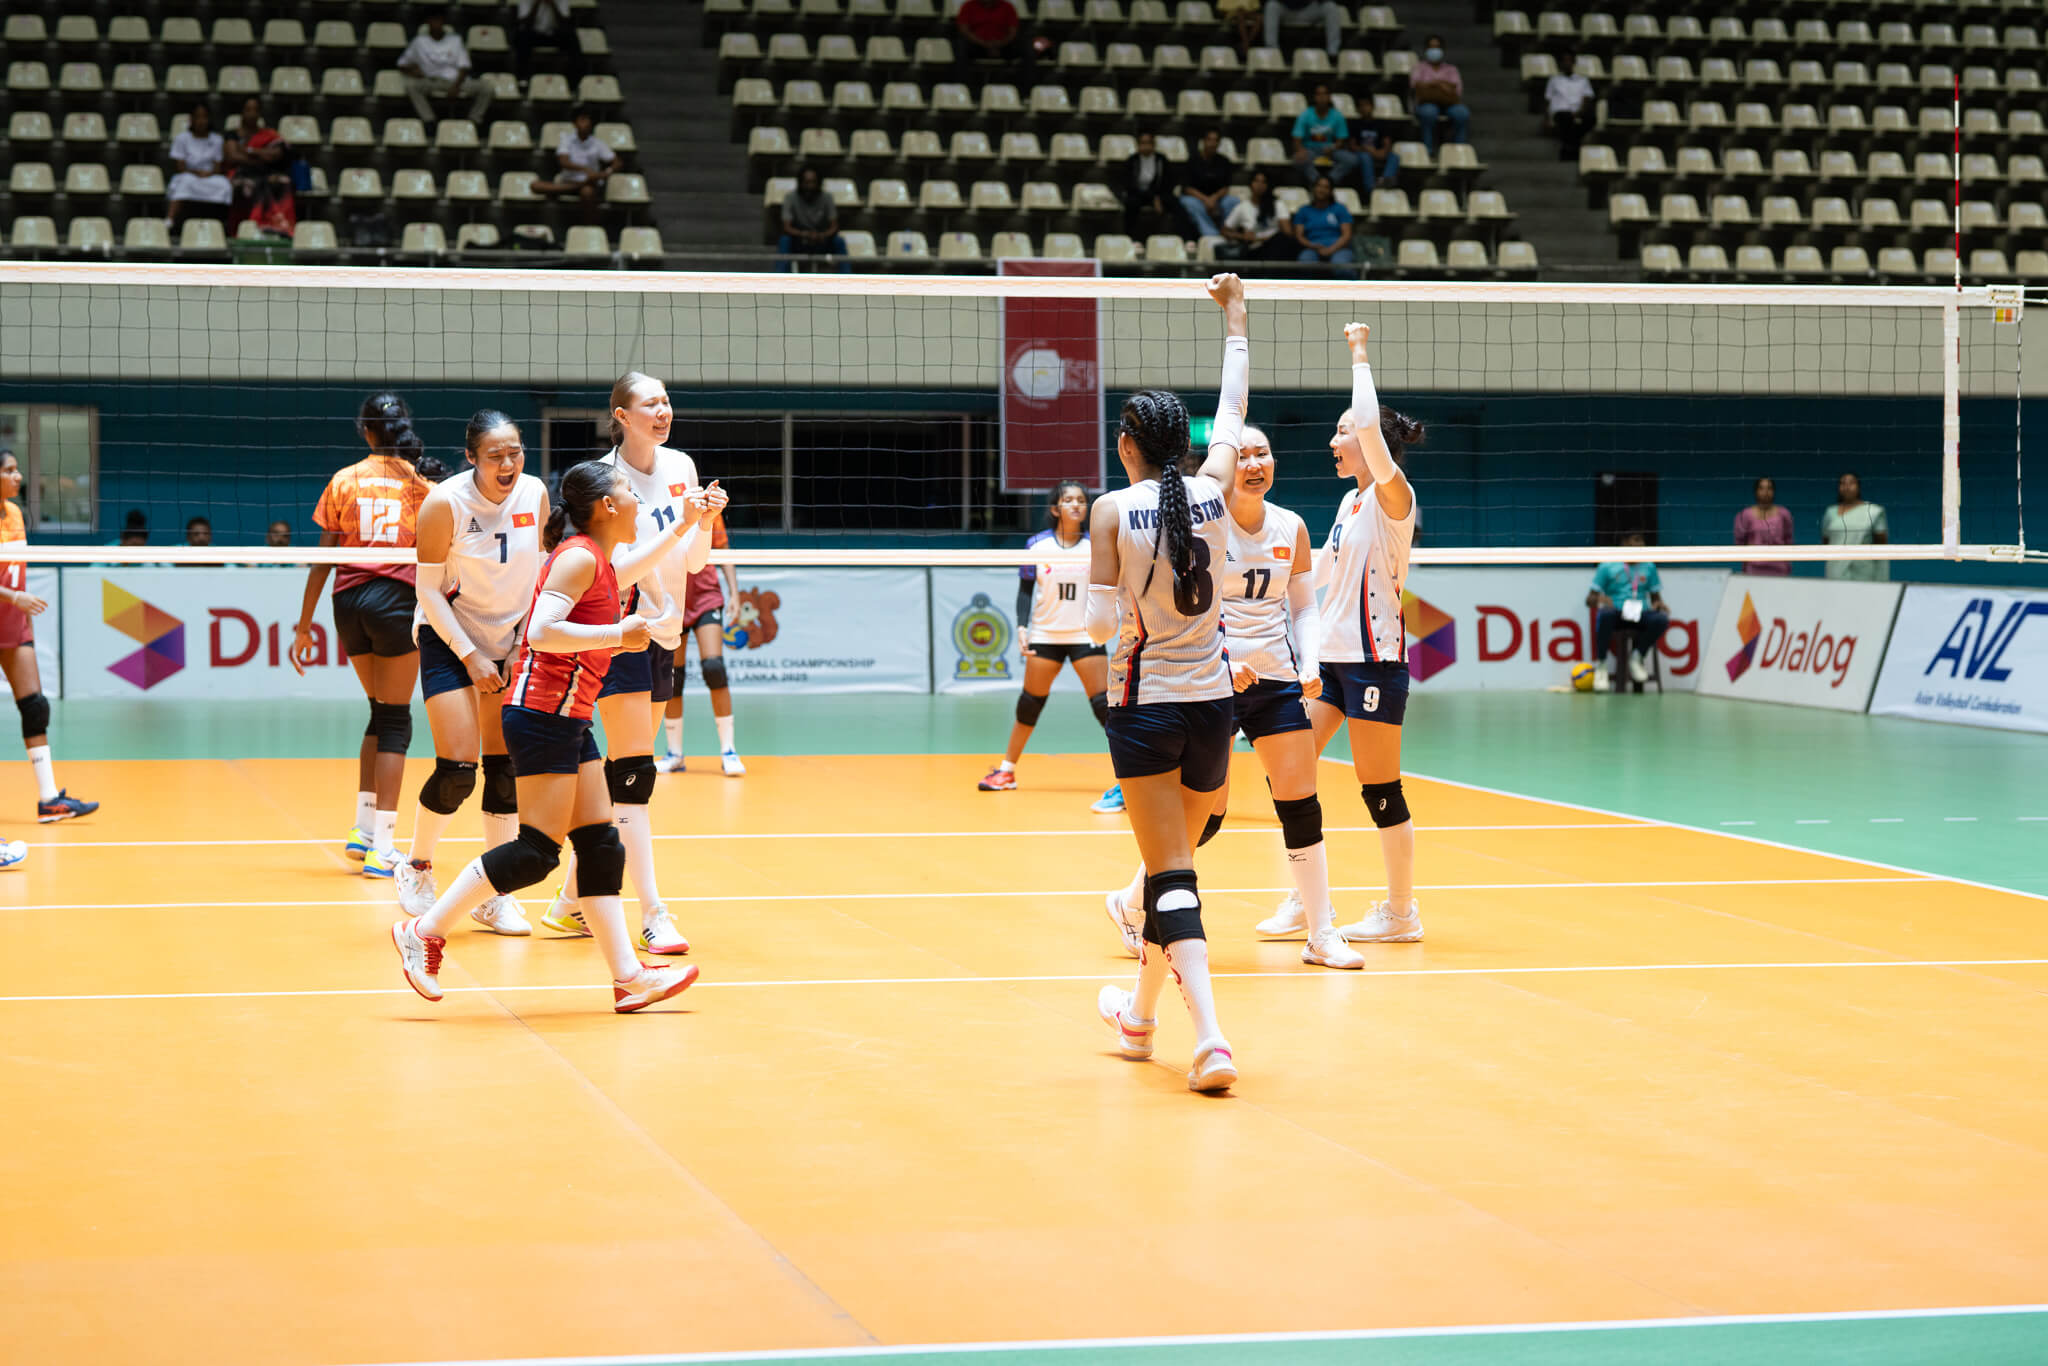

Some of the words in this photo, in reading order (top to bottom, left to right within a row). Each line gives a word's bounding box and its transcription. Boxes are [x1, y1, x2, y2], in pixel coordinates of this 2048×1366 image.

[356, 497, 400, 543] 12
[651, 505, 676, 532] 11
[494, 533, 507, 563] 1
[1058, 583, 1077, 600] 10
[1173, 537, 1213, 616] 8
[1242, 568, 1271, 599] 17
[1475, 605, 1699, 675] Dialg
[1760, 617, 1858, 689] Dialog
[1923, 598, 2048, 682] AVC
[1362, 686, 1381, 712] 9
